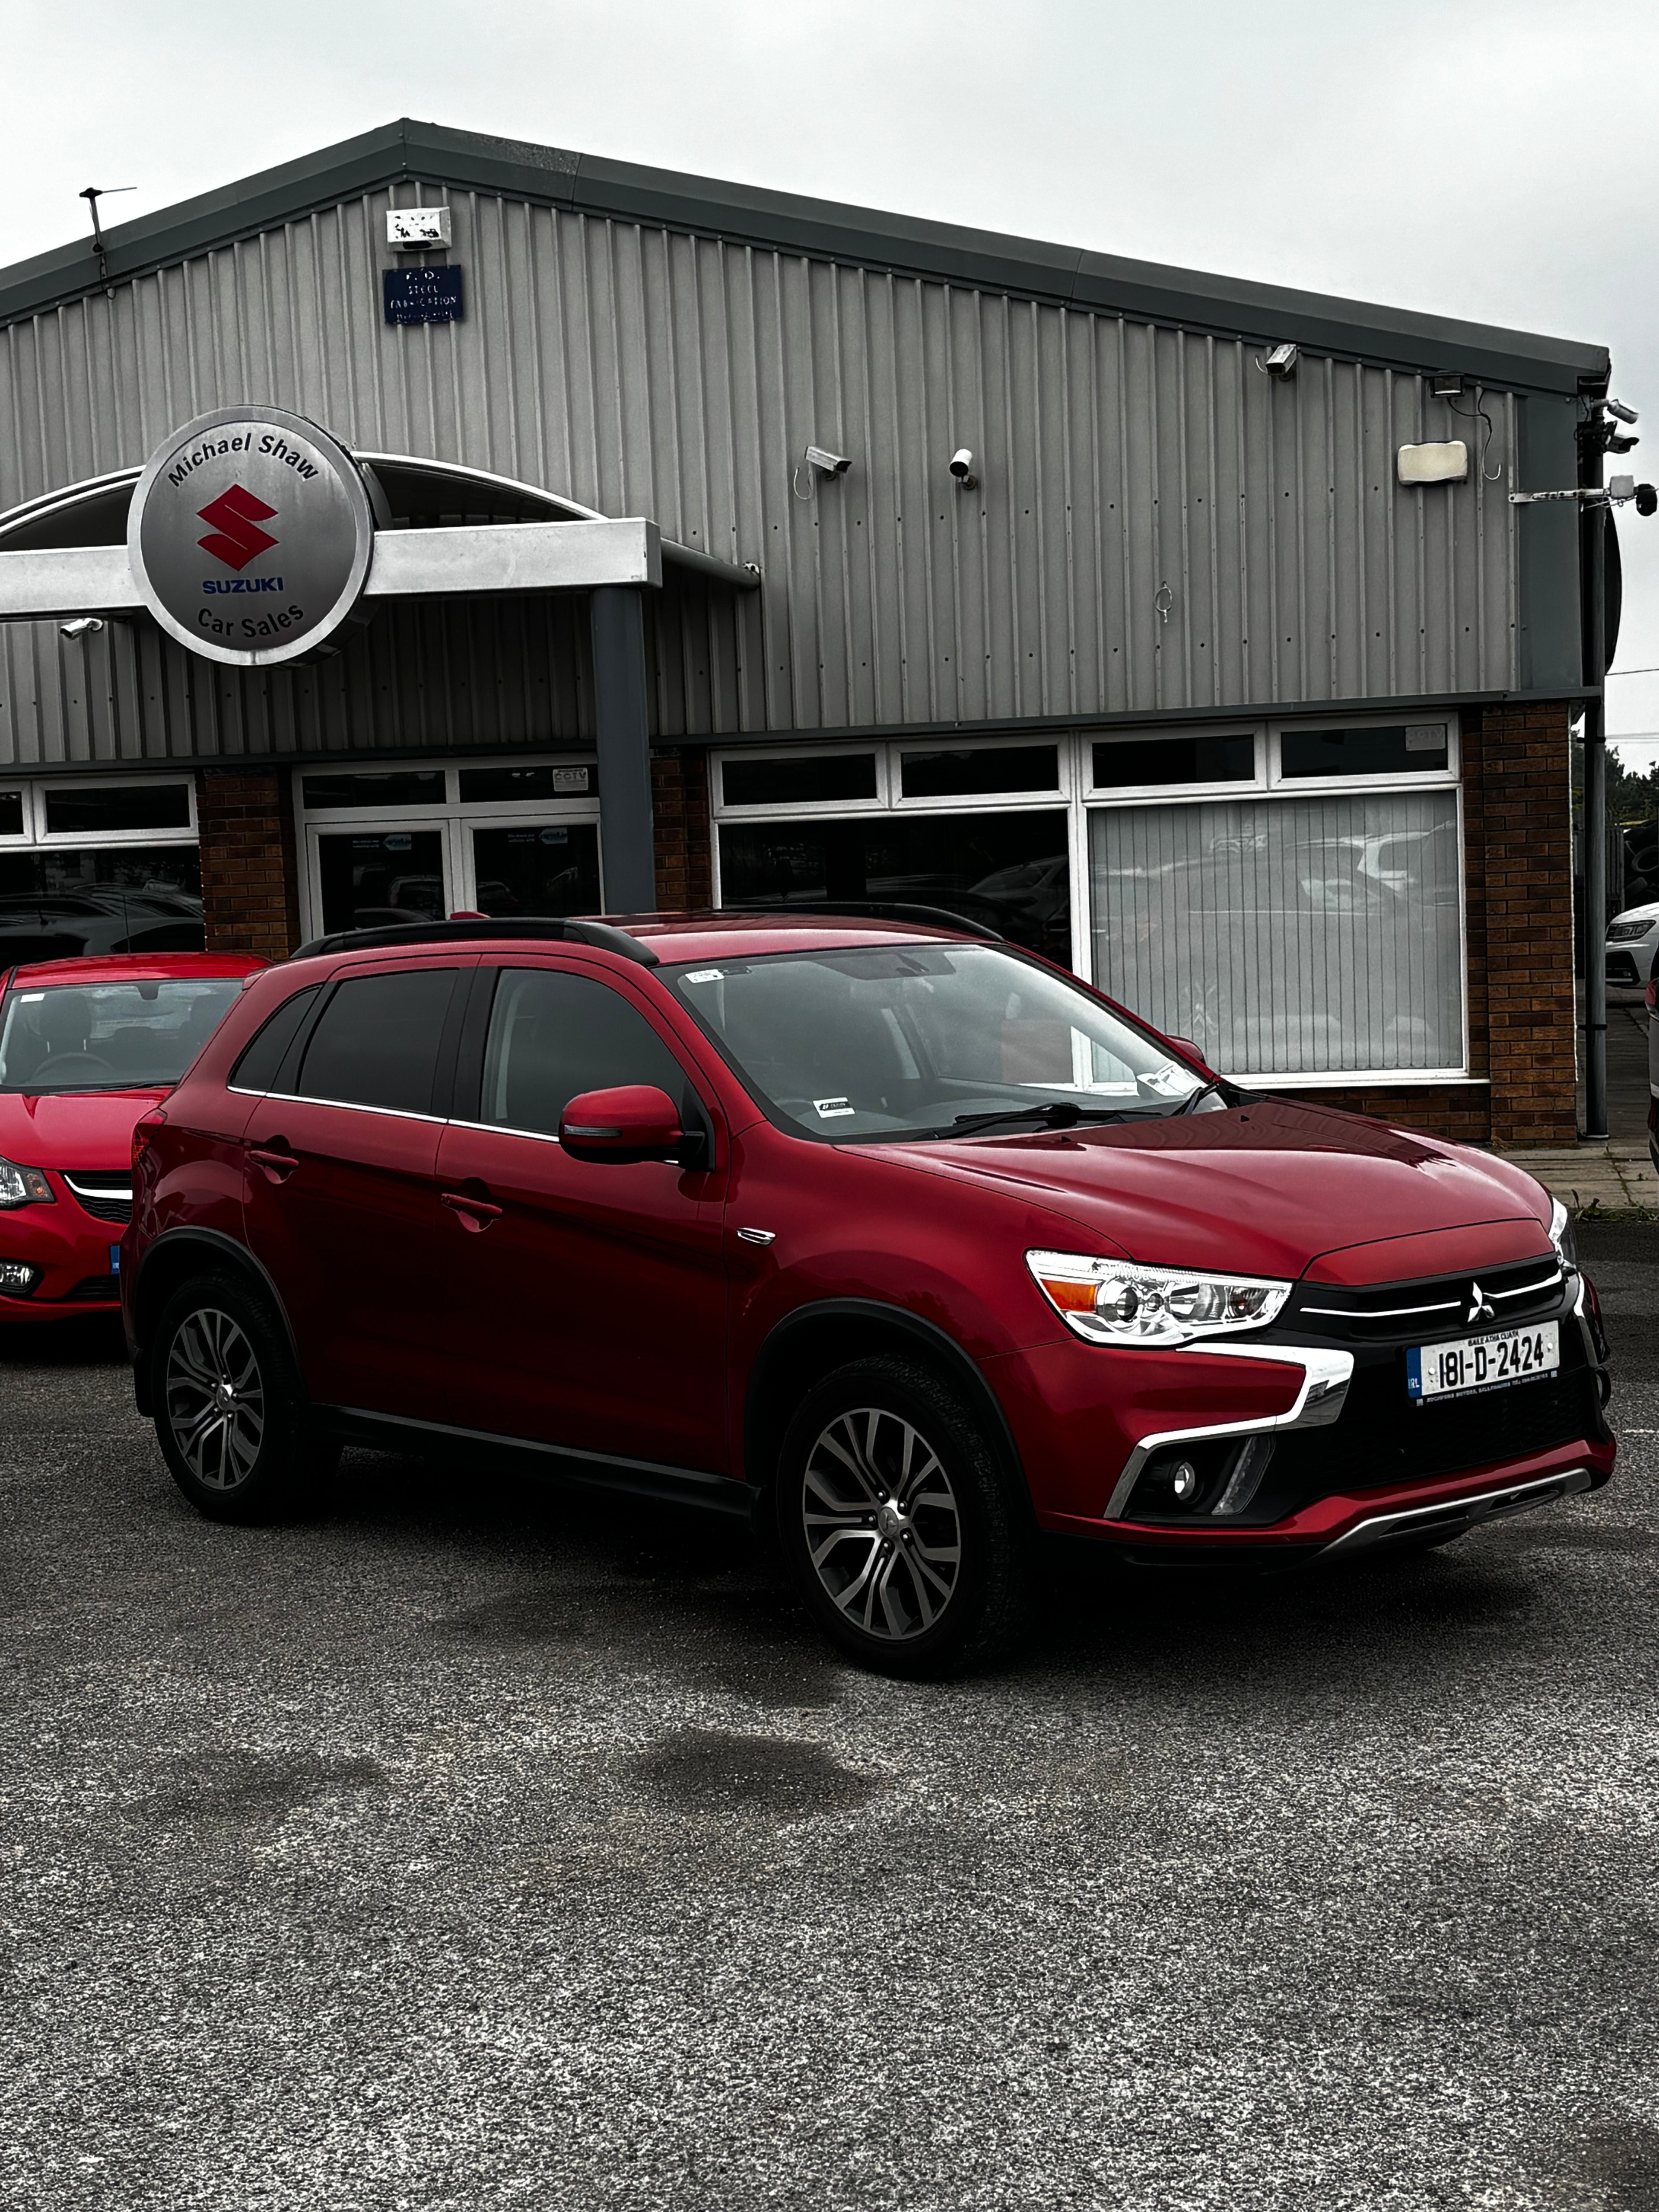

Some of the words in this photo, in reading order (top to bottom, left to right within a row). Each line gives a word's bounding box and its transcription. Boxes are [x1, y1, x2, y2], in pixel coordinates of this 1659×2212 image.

[168, 432, 252, 487] Michael
[258, 435, 319, 480] Shaw
[203, 577, 284, 594] SUZUKI
[198, 608, 234, 636] Car
[241, 604, 304, 638] Sales
[1439, 1333, 1544, 1389] 181-D-2424
